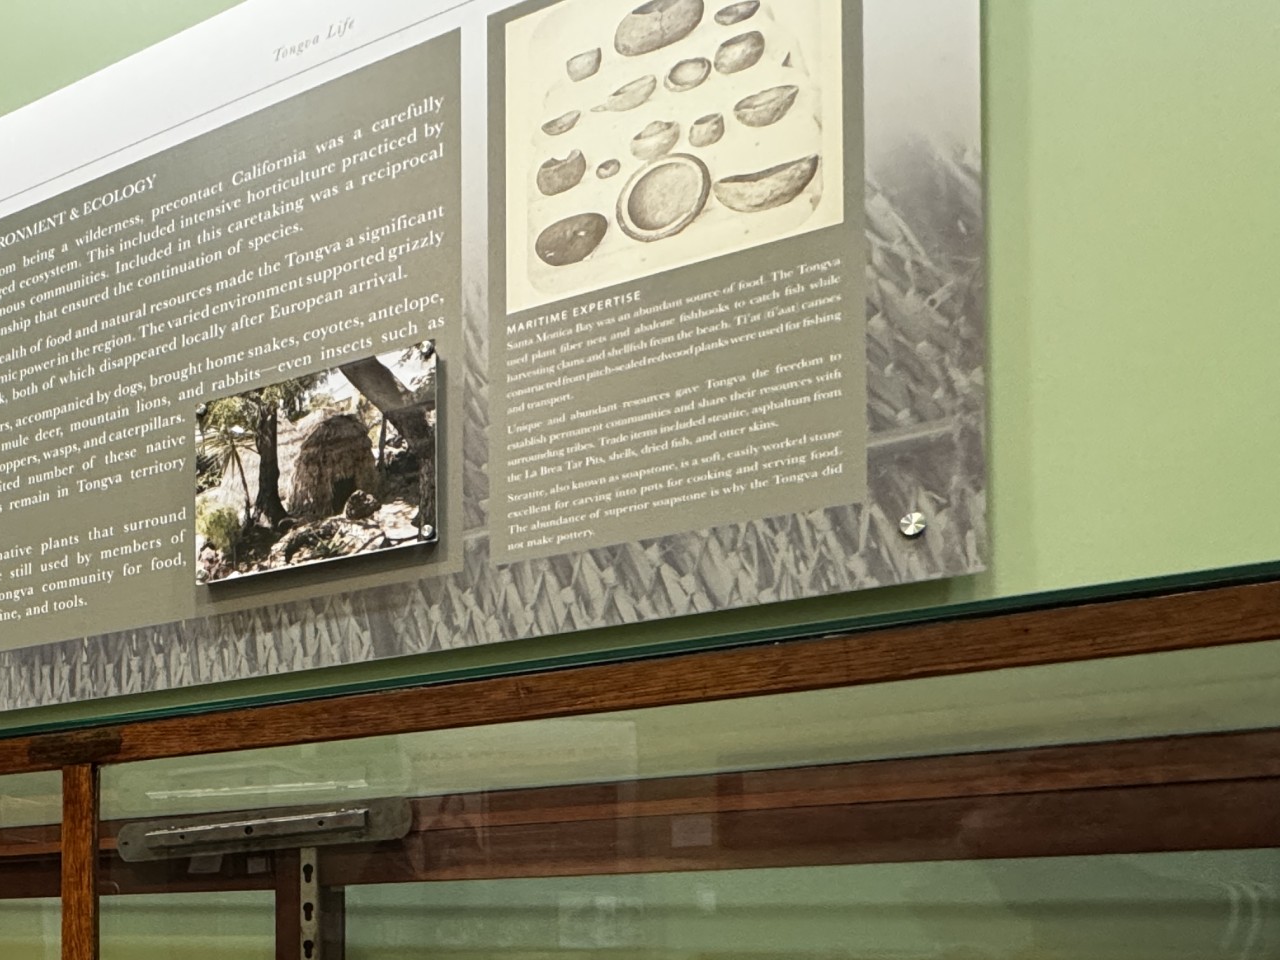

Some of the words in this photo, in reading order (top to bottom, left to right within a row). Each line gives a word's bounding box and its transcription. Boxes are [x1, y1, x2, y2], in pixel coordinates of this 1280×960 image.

[272, 34, 319, 62] Tongva
[326, 16, 354, 39] Life
[19, 260, 81, 289] ecosystem.
[86, 244, 115, 263] This
[119, 218, 175, 252] included
[180, 198, 241, 229] intensive
[246, 162, 336, 204] horticulture
[341, 127, 417, 173] practiced
[424, 122, 444, 138] by
[22, 247, 55, 267] being
[61, 243, 68, 253] a
[75, 214, 144, 246] wilderness,
[151, 181, 223, 222] precontact
[231, 149, 306, 186] California
[315, 135, 344, 154] was
[353, 128, 362, 140] a
[371, 95, 444, 132] carefully
[69, 207, 80, 221] &
[83, 173, 156, 215] ECOLOGY
[29, 270, 109, 305] communities.
[115, 241, 172, 274] Included
[178, 238, 191, 252] in
[197, 226, 222, 245] this
[227, 197, 304, 233] caretaking
[310, 185, 339, 203] was
[345, 179, 354, 191] a
[361, 142, 443, 185] reciprocal
[34, 307, 57, 324] that
[61, 286, 109, 314] ensured
[113, 281, 133, 296] the
[137, 250, 222, 287] continuation
[227, 238, 243, 256] of
[248, 222, 303, 251] species.
[506, 310, 567, 335] MARITIME
[572, 290, 640, 317] EXPERTISE
[9, 490, 50, 510] remain
[57, 485, 69, 498] in
[76, 473, 122, 493] Tongva
[130, 457, 186, 479] territory
[9, 562, 32, 578] still
[40, 554, 68, 572] used
[76, 551, 91, 567] by
[100, 538, 162, 560] members
[170, 528, 186, 544] of
[40, 535, 79, 555] plants
[88, 526, 114, 541] that
[123, 506, 186, 533] surround
[41, 568, 114, 592] community
[122, 562, 142, 576] for
[151, 551, 186, 571] food,
[25, 600, 48, 616] and
[53, 594, 87, 611] tools.
